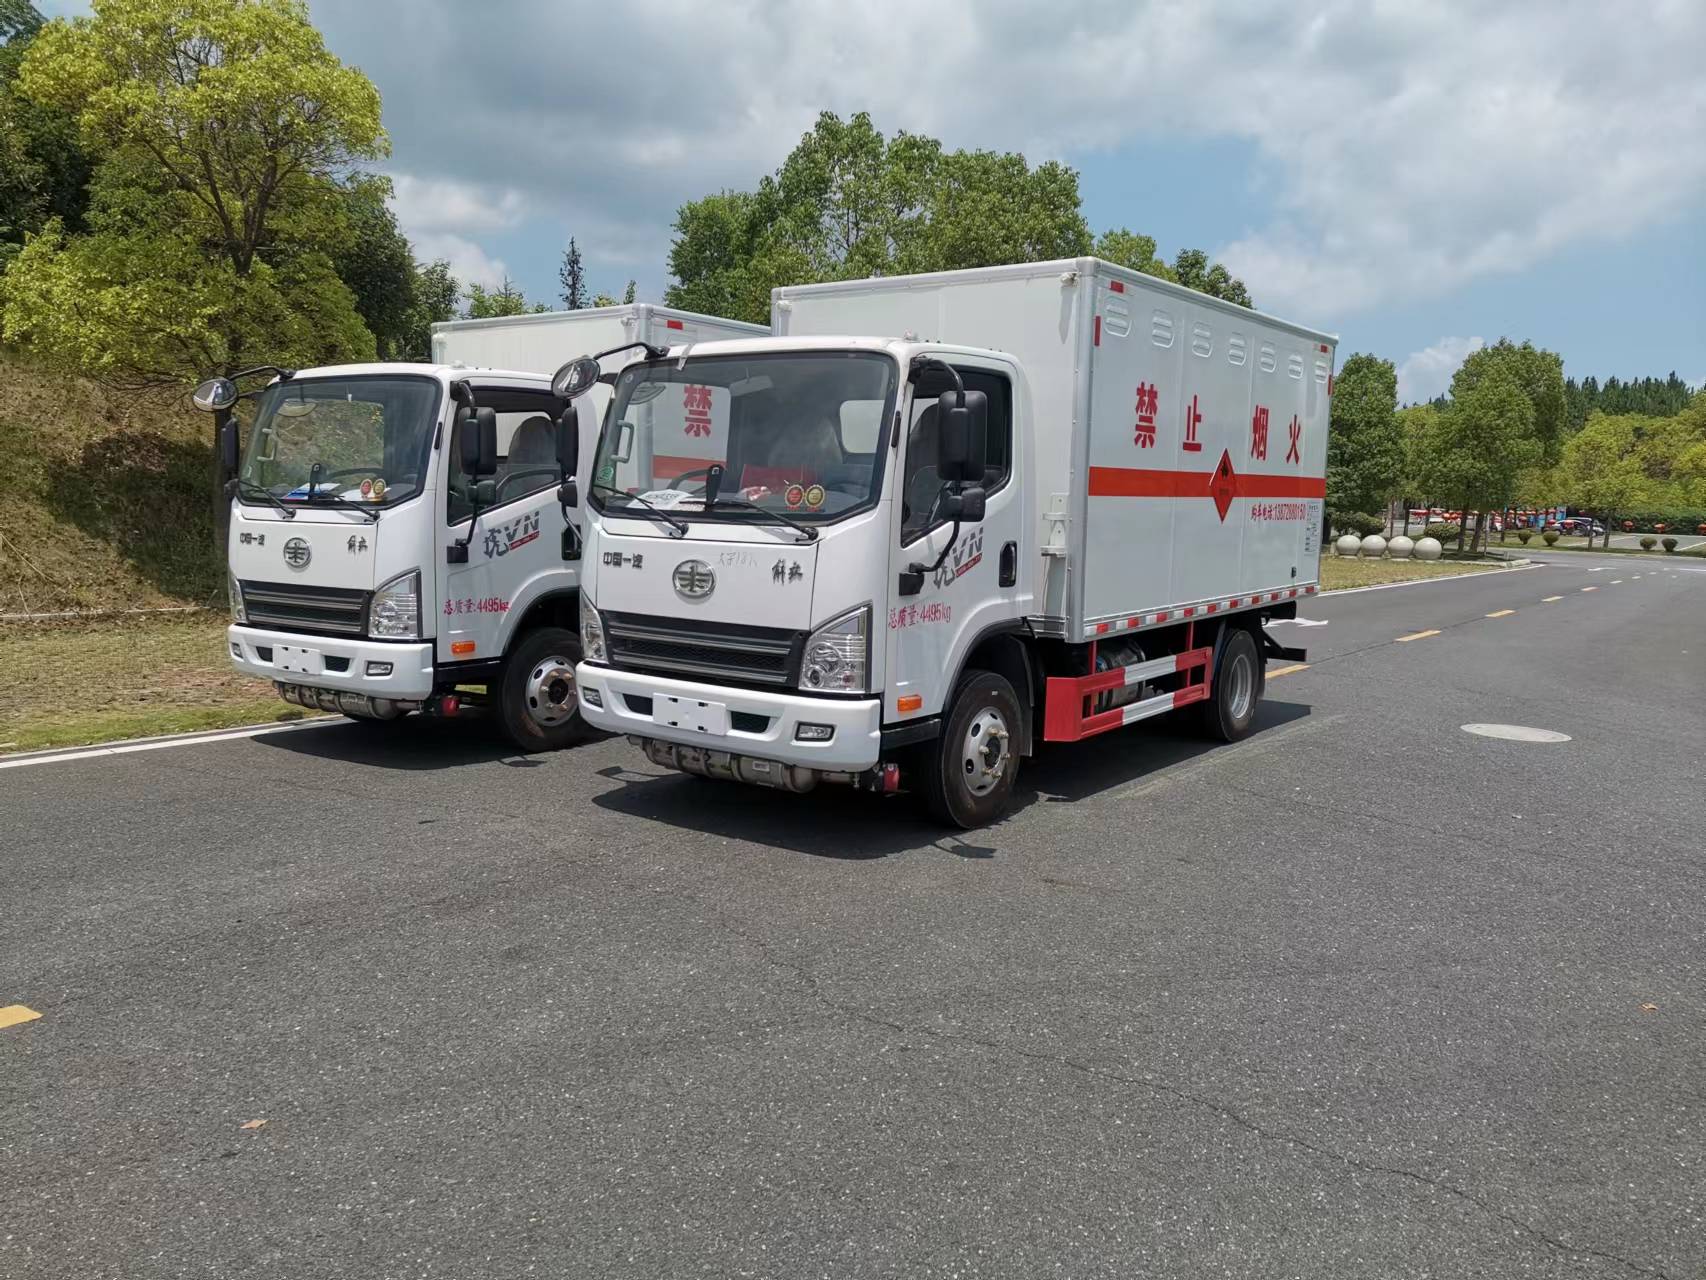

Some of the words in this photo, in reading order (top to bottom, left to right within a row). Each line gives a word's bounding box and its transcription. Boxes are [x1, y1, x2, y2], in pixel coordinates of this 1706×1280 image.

[1134, 381, 1300, 465] 禁止烟火
[603, 551, 643, 569] 中国一汽
[771, 558, 803, 586] 解放
